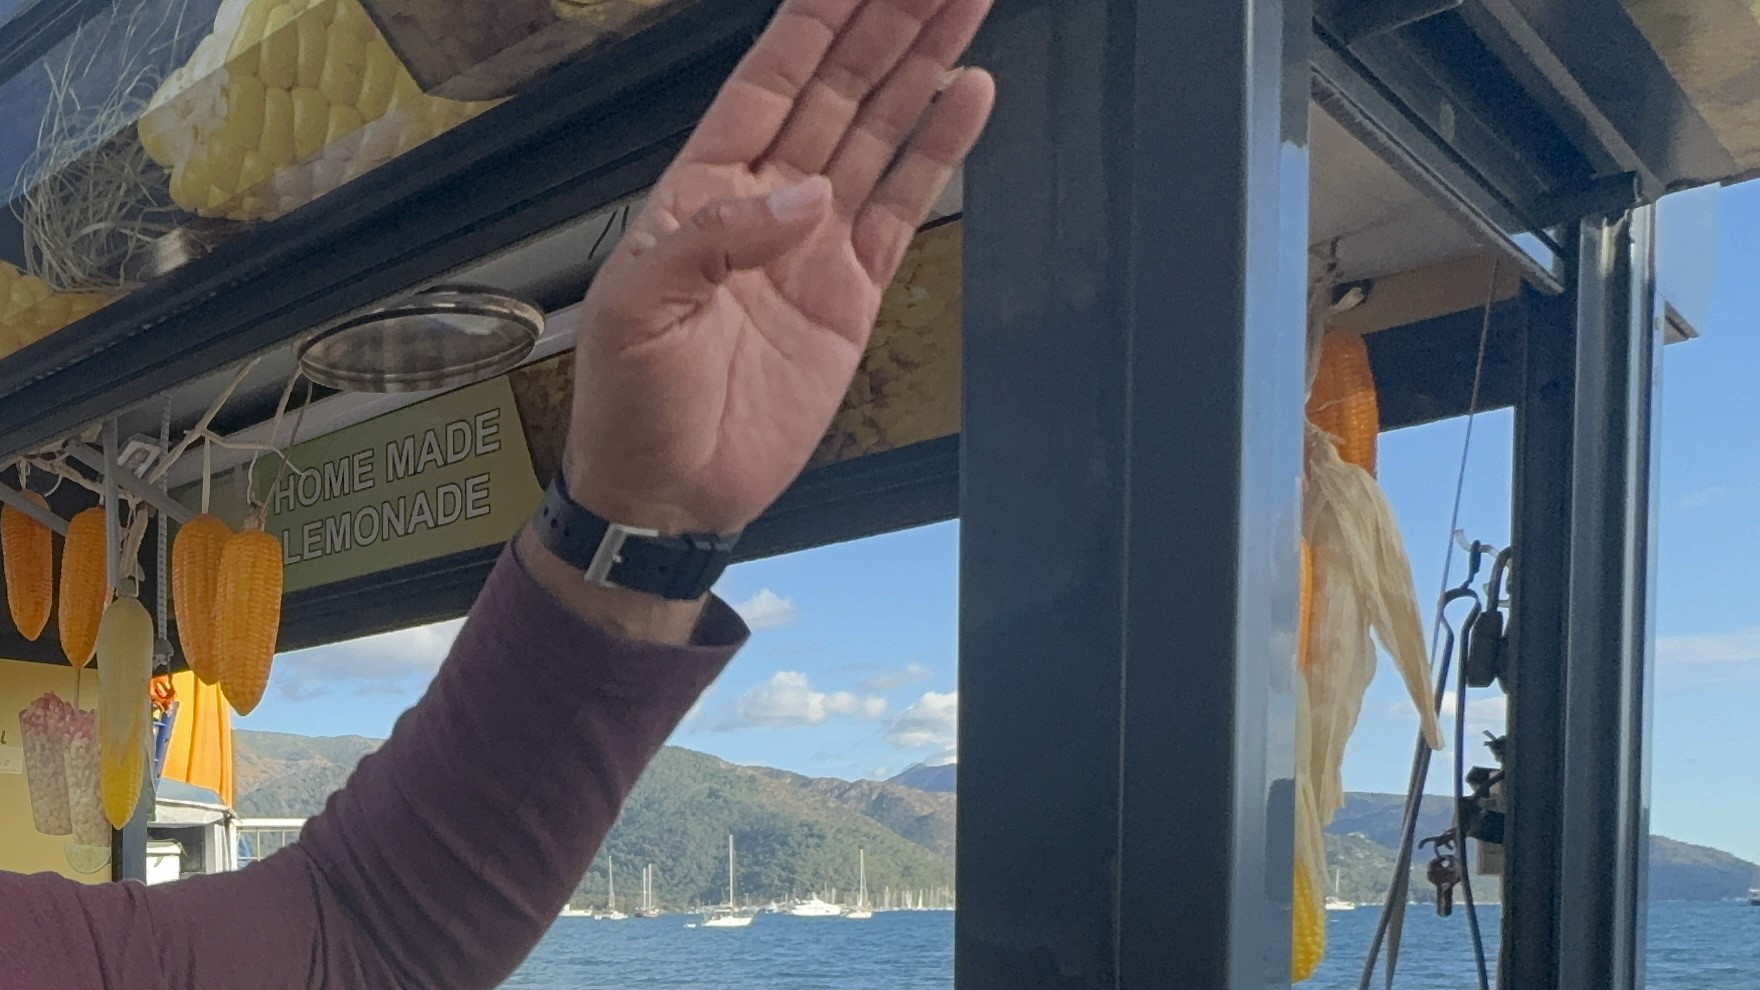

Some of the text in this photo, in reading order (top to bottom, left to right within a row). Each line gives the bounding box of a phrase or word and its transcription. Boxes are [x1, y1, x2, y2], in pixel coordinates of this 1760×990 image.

[274, 407, 502, 515] HOME MADE
[282, 471, 491, 566] LEMONADE
[0, 729, 7, 745] L
